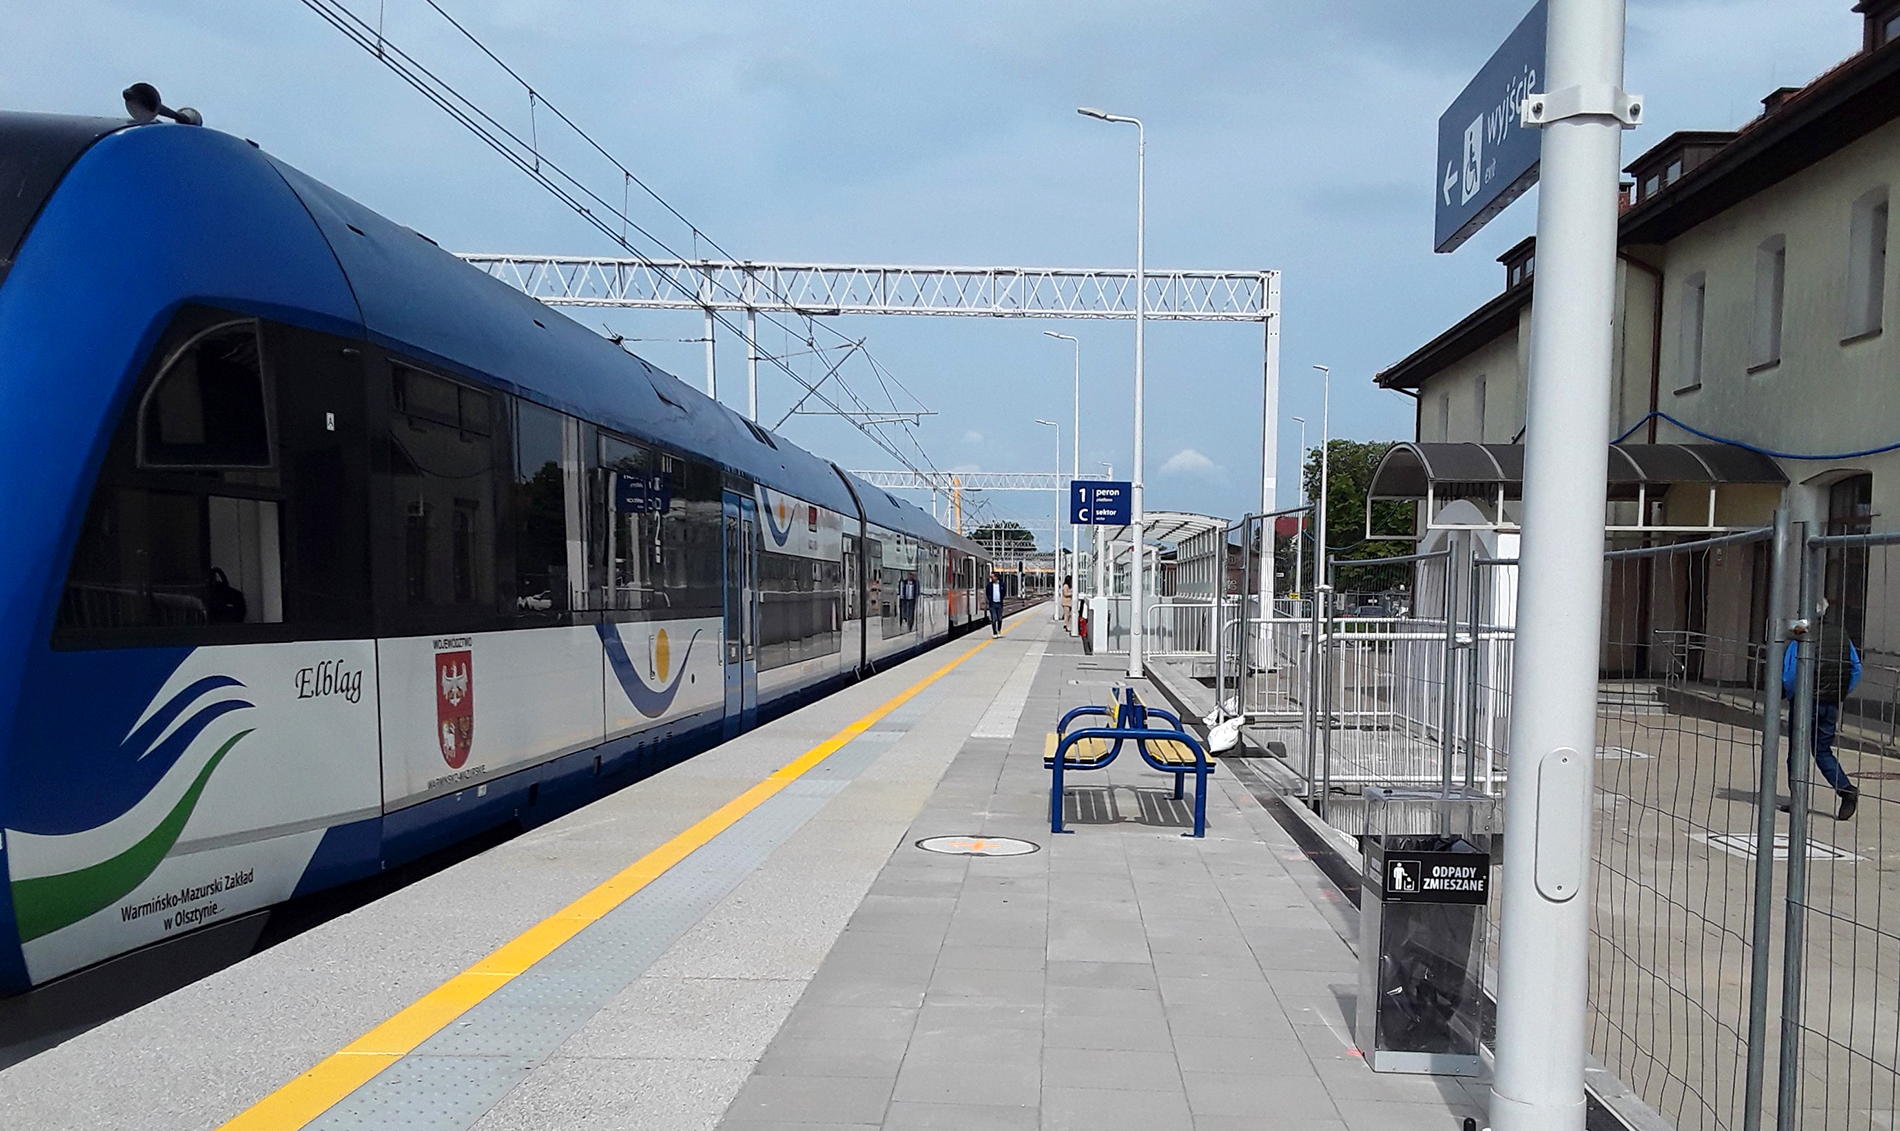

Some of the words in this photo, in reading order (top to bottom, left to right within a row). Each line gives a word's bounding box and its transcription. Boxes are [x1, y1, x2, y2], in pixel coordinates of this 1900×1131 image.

[1487, 64, 1536, 146] wyjście
[1079, 488, 1086, 503] 1
[1096, 489, 1120, 497] peron
[1078, 508, 1089, 521] C
[1096, 508, 1117, 516] sektor
[1432, 866, 1477, 879] ODPADY
[1423, 878, 1484, 892] ZMIESZANE
[121, 877, 223, 923] Warmińsko-Mazurski
[224, 868, 254, 891] Zakład
[163, 916, 173, 931] w
[175, 901, 218, 927] Olsztynie
